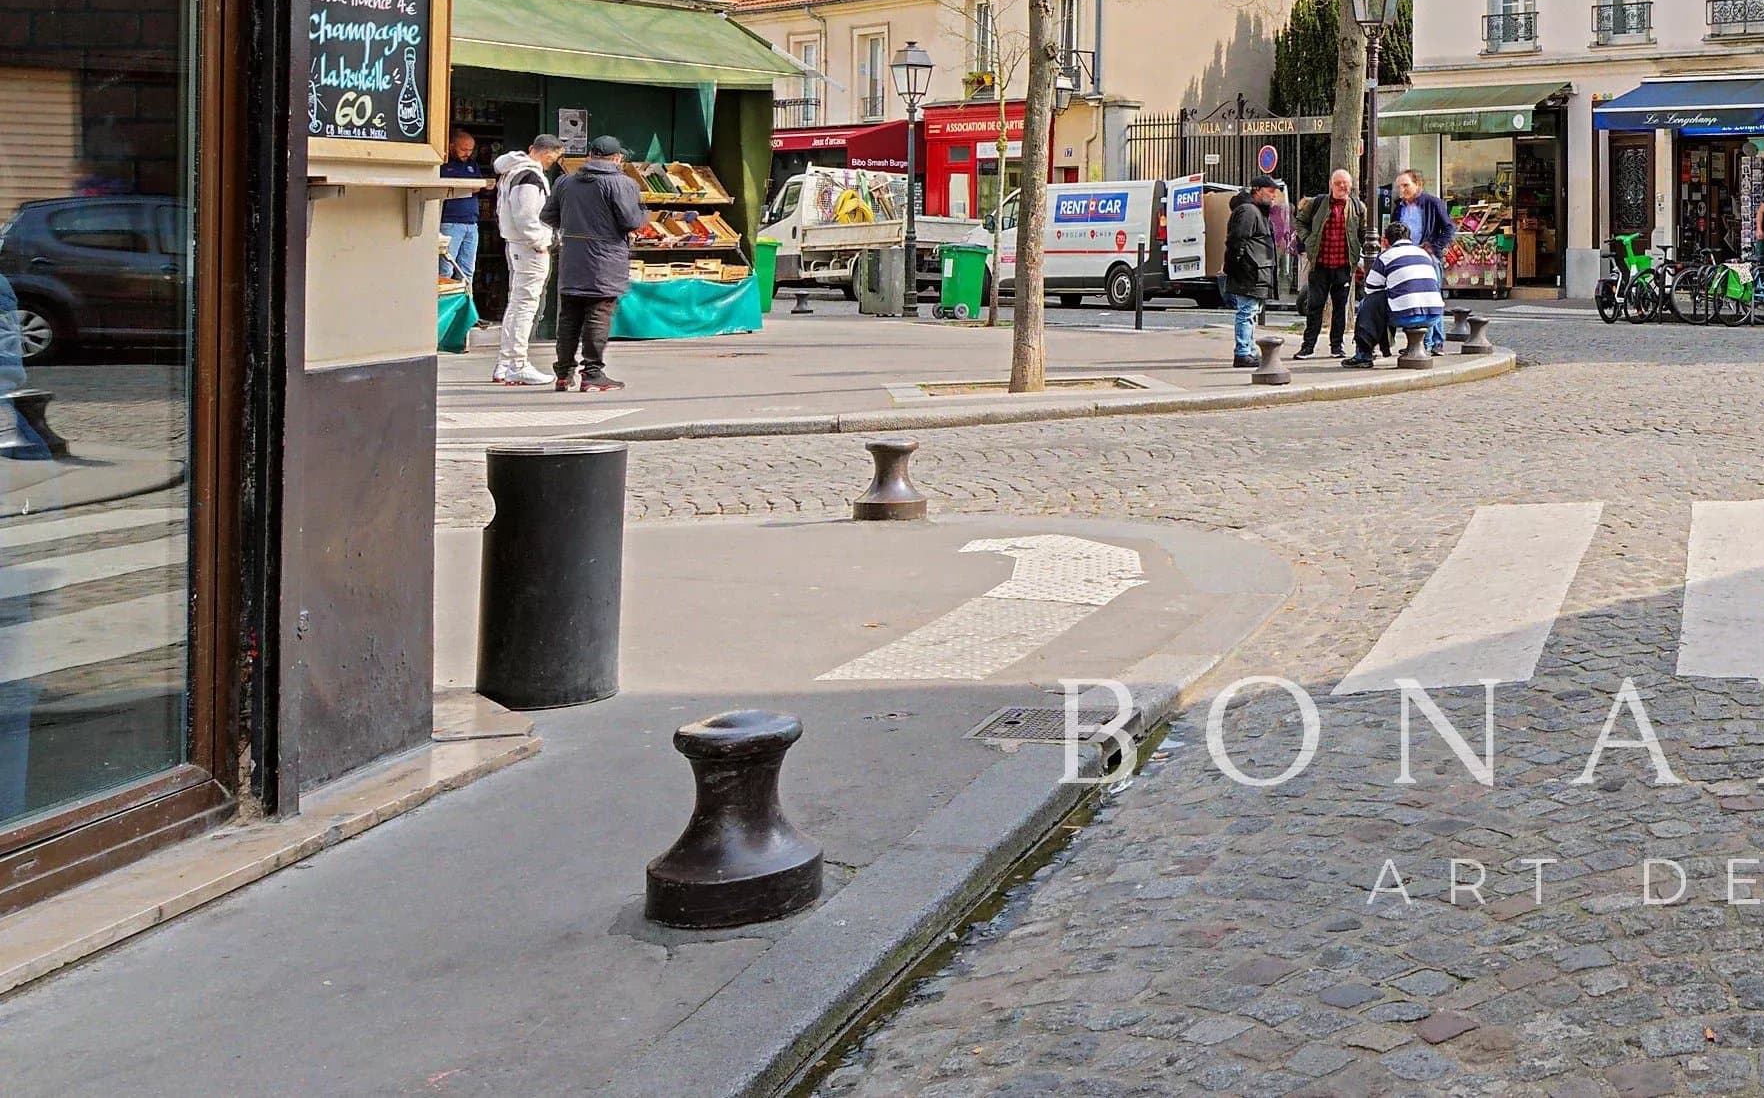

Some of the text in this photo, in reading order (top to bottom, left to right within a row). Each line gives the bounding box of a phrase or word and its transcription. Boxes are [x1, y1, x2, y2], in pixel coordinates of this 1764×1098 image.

[309, 8, 421, 64] Champagne
[945, 122, 986, 132] ASSOCIATION
[987, 122, 996, 131] DE
[996, 120, 1025, 130] QARTIE
[1198, 118, 1324, 134] VILLA LAURENCIA 19
[1666, 112, 1717, 127] Longchamp
[812, 138, 825, 147] Jeux
[851, 158, 866, 167] Bibo
[867, 158, 889, 167] Smash
[1177, 191, 1199, 206] RENT
[1060, 201, 1087, 215] RENT
[1098, 199, 1121, 214] CAR
